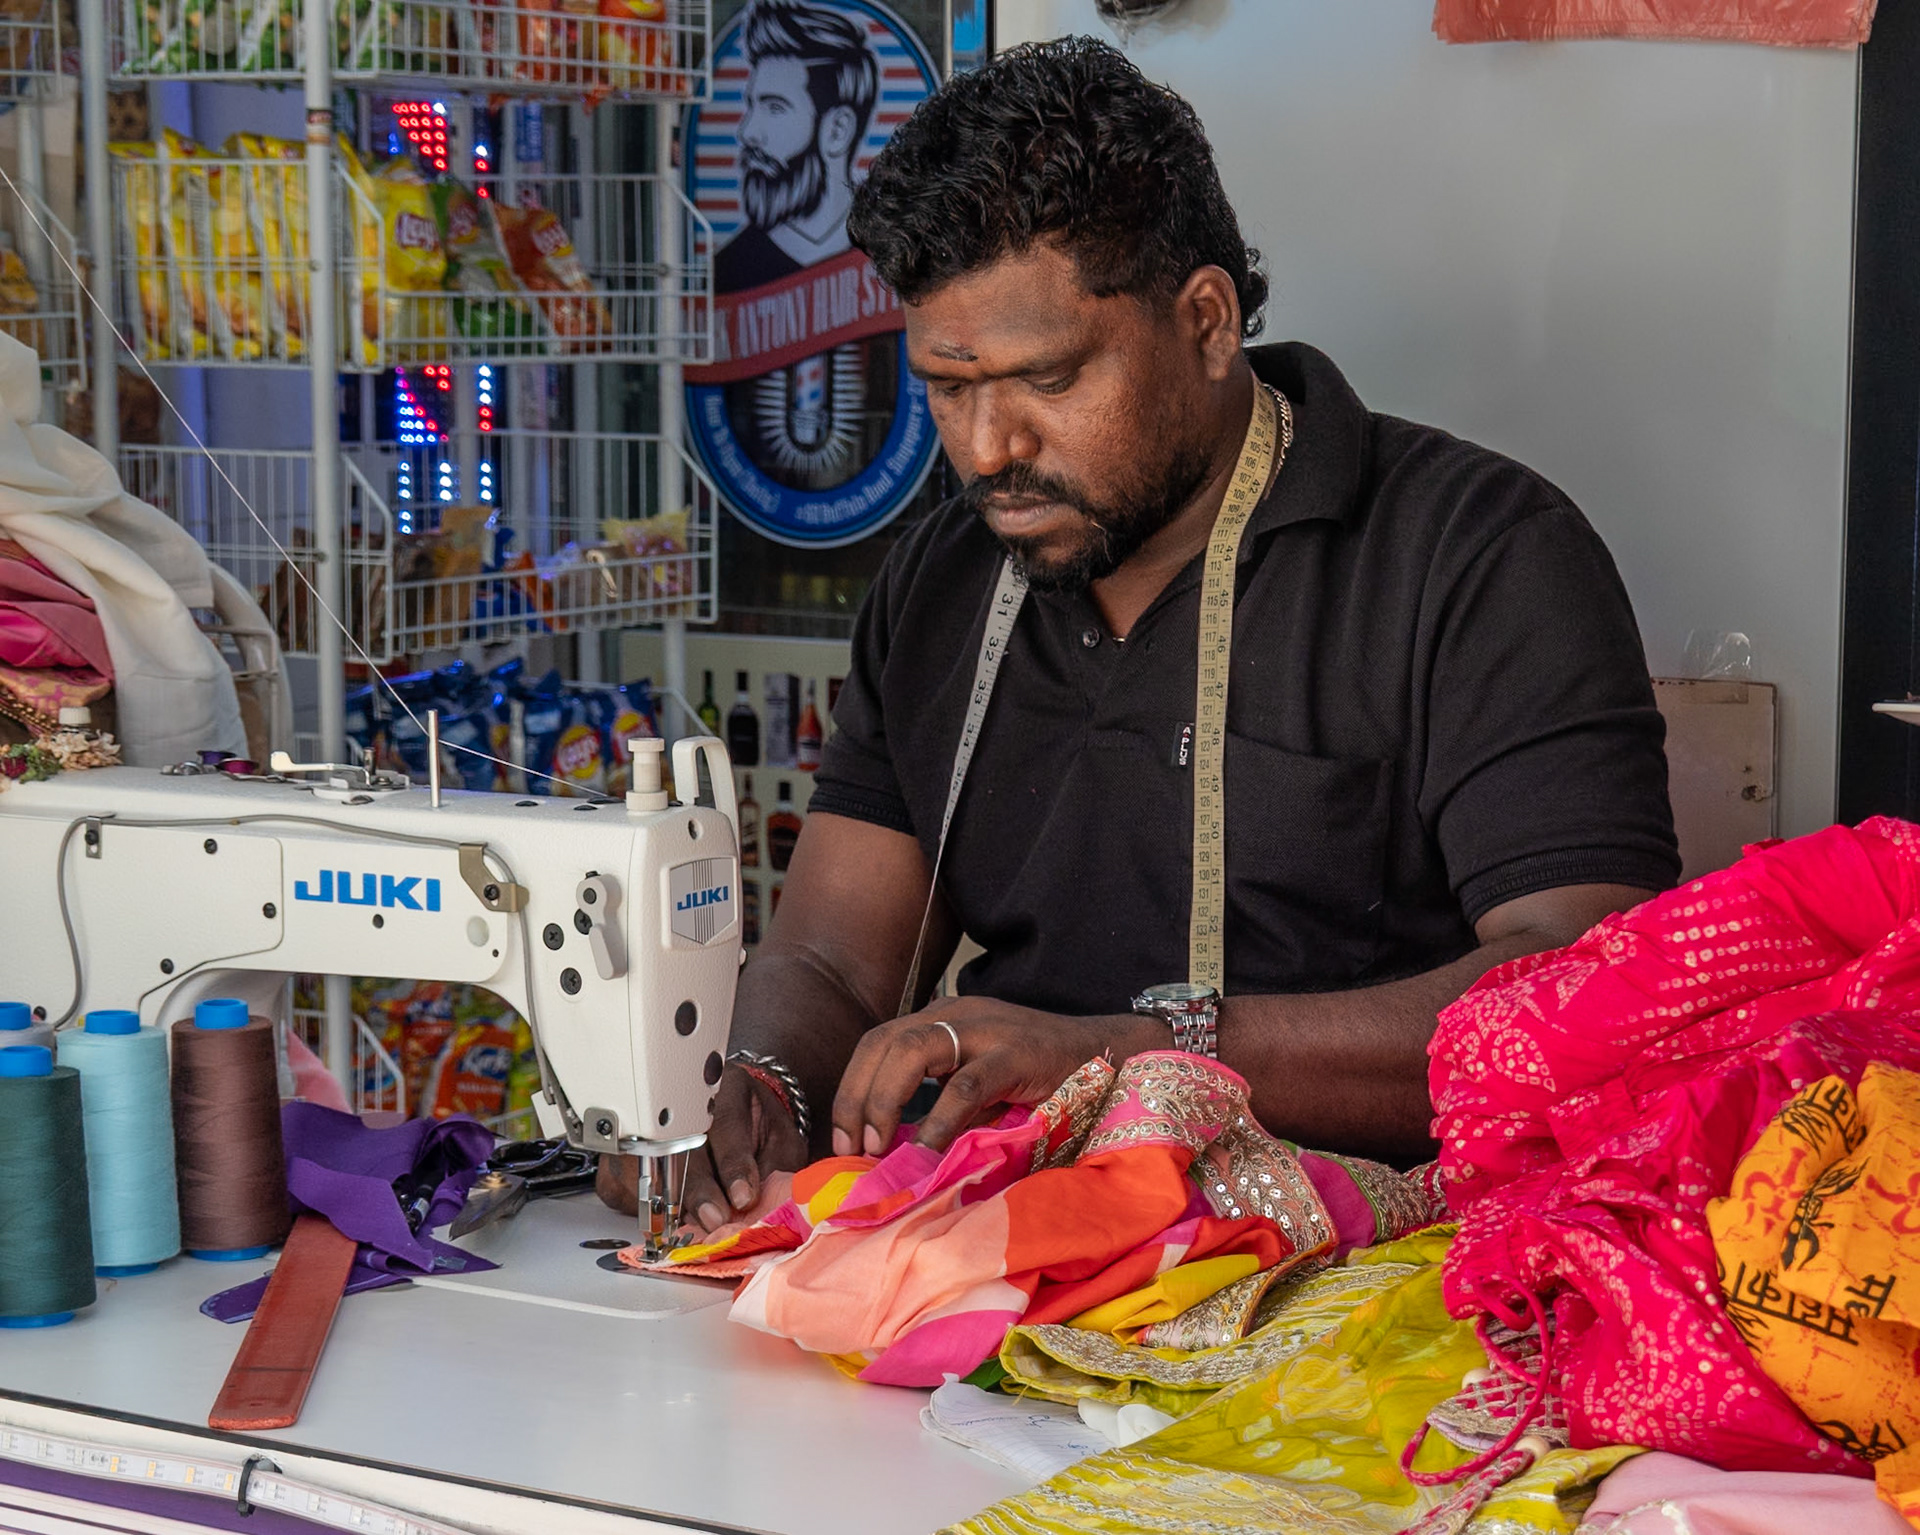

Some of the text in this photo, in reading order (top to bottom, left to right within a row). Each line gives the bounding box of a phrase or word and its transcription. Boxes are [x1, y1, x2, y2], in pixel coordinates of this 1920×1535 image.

[813, 267, 859, 334] HAIR
[1250, 441, 1261, 453] 105
[1244, 456, 1257, 469] 106
[1240, 472, 1251, 485] 107
[1250, 479, 1260, 494] 42
[1233, 488, 1246, 500] 108
[1227, 504, 1240, 513] 109
[1222, 517, 1234, 525] 110
[1216, 529, 1228, 538] 111
[1213, 543, 1225, 554] 112
[1224, 545, 1234, 561] 44
[1210, 561, 1222, 571] 113
[1208, 578, 1220, 588] 114
[1207, 595, 1218, 606] 115
[1220, 589, 1229, 607] 45
[997, 593, 1014, 617] 31
[1206, 613, 1217, 624] 116
[1205, 631, 1217, 643] 117
[984, 636, 999, 662] 32
[1217, 635, 1226, 653] 46
[1204, 650, 1216, 661] 118
[1204, 668, 1215, 679] 119
[1203, 686, 1215, 697] 120
[1215, 681, 1224, 699] 47
[1202, 704, 1213, 716] 121
[1201, 722, 1212, 733] 122
[1212, 727, 1220, 746] 48
[1200, 741, 1211, 752] 123
[1199, 759, 1210, 770] 124
[1199, 777, 1210, 789] 125
[1200, 796, 1211, 807] 126
[1200, 814, 1210, 825] 127
[1211, 821, 1220, 840] 50
[1199, 832, 1210, 844] 128
[1199, 851, 1210, 862] 129
[1199, 869, 1210, 881] 130
[1211, 868, 1220, 885] 51
[294, 869, 441, 912] JUKI
[1198, 888, 1209, 900] 131
[677, 885, 728, 911] JUKI
[1197, 906, 1209, 918] 132
[1196, 924, 1208, 936] 133
[1209, 915, 1219, 933] 52
[1195, 942, 1207, 954] 134
[1195, 961, 1208, 973] 135
[1209, 962, 1219, 980] 53
